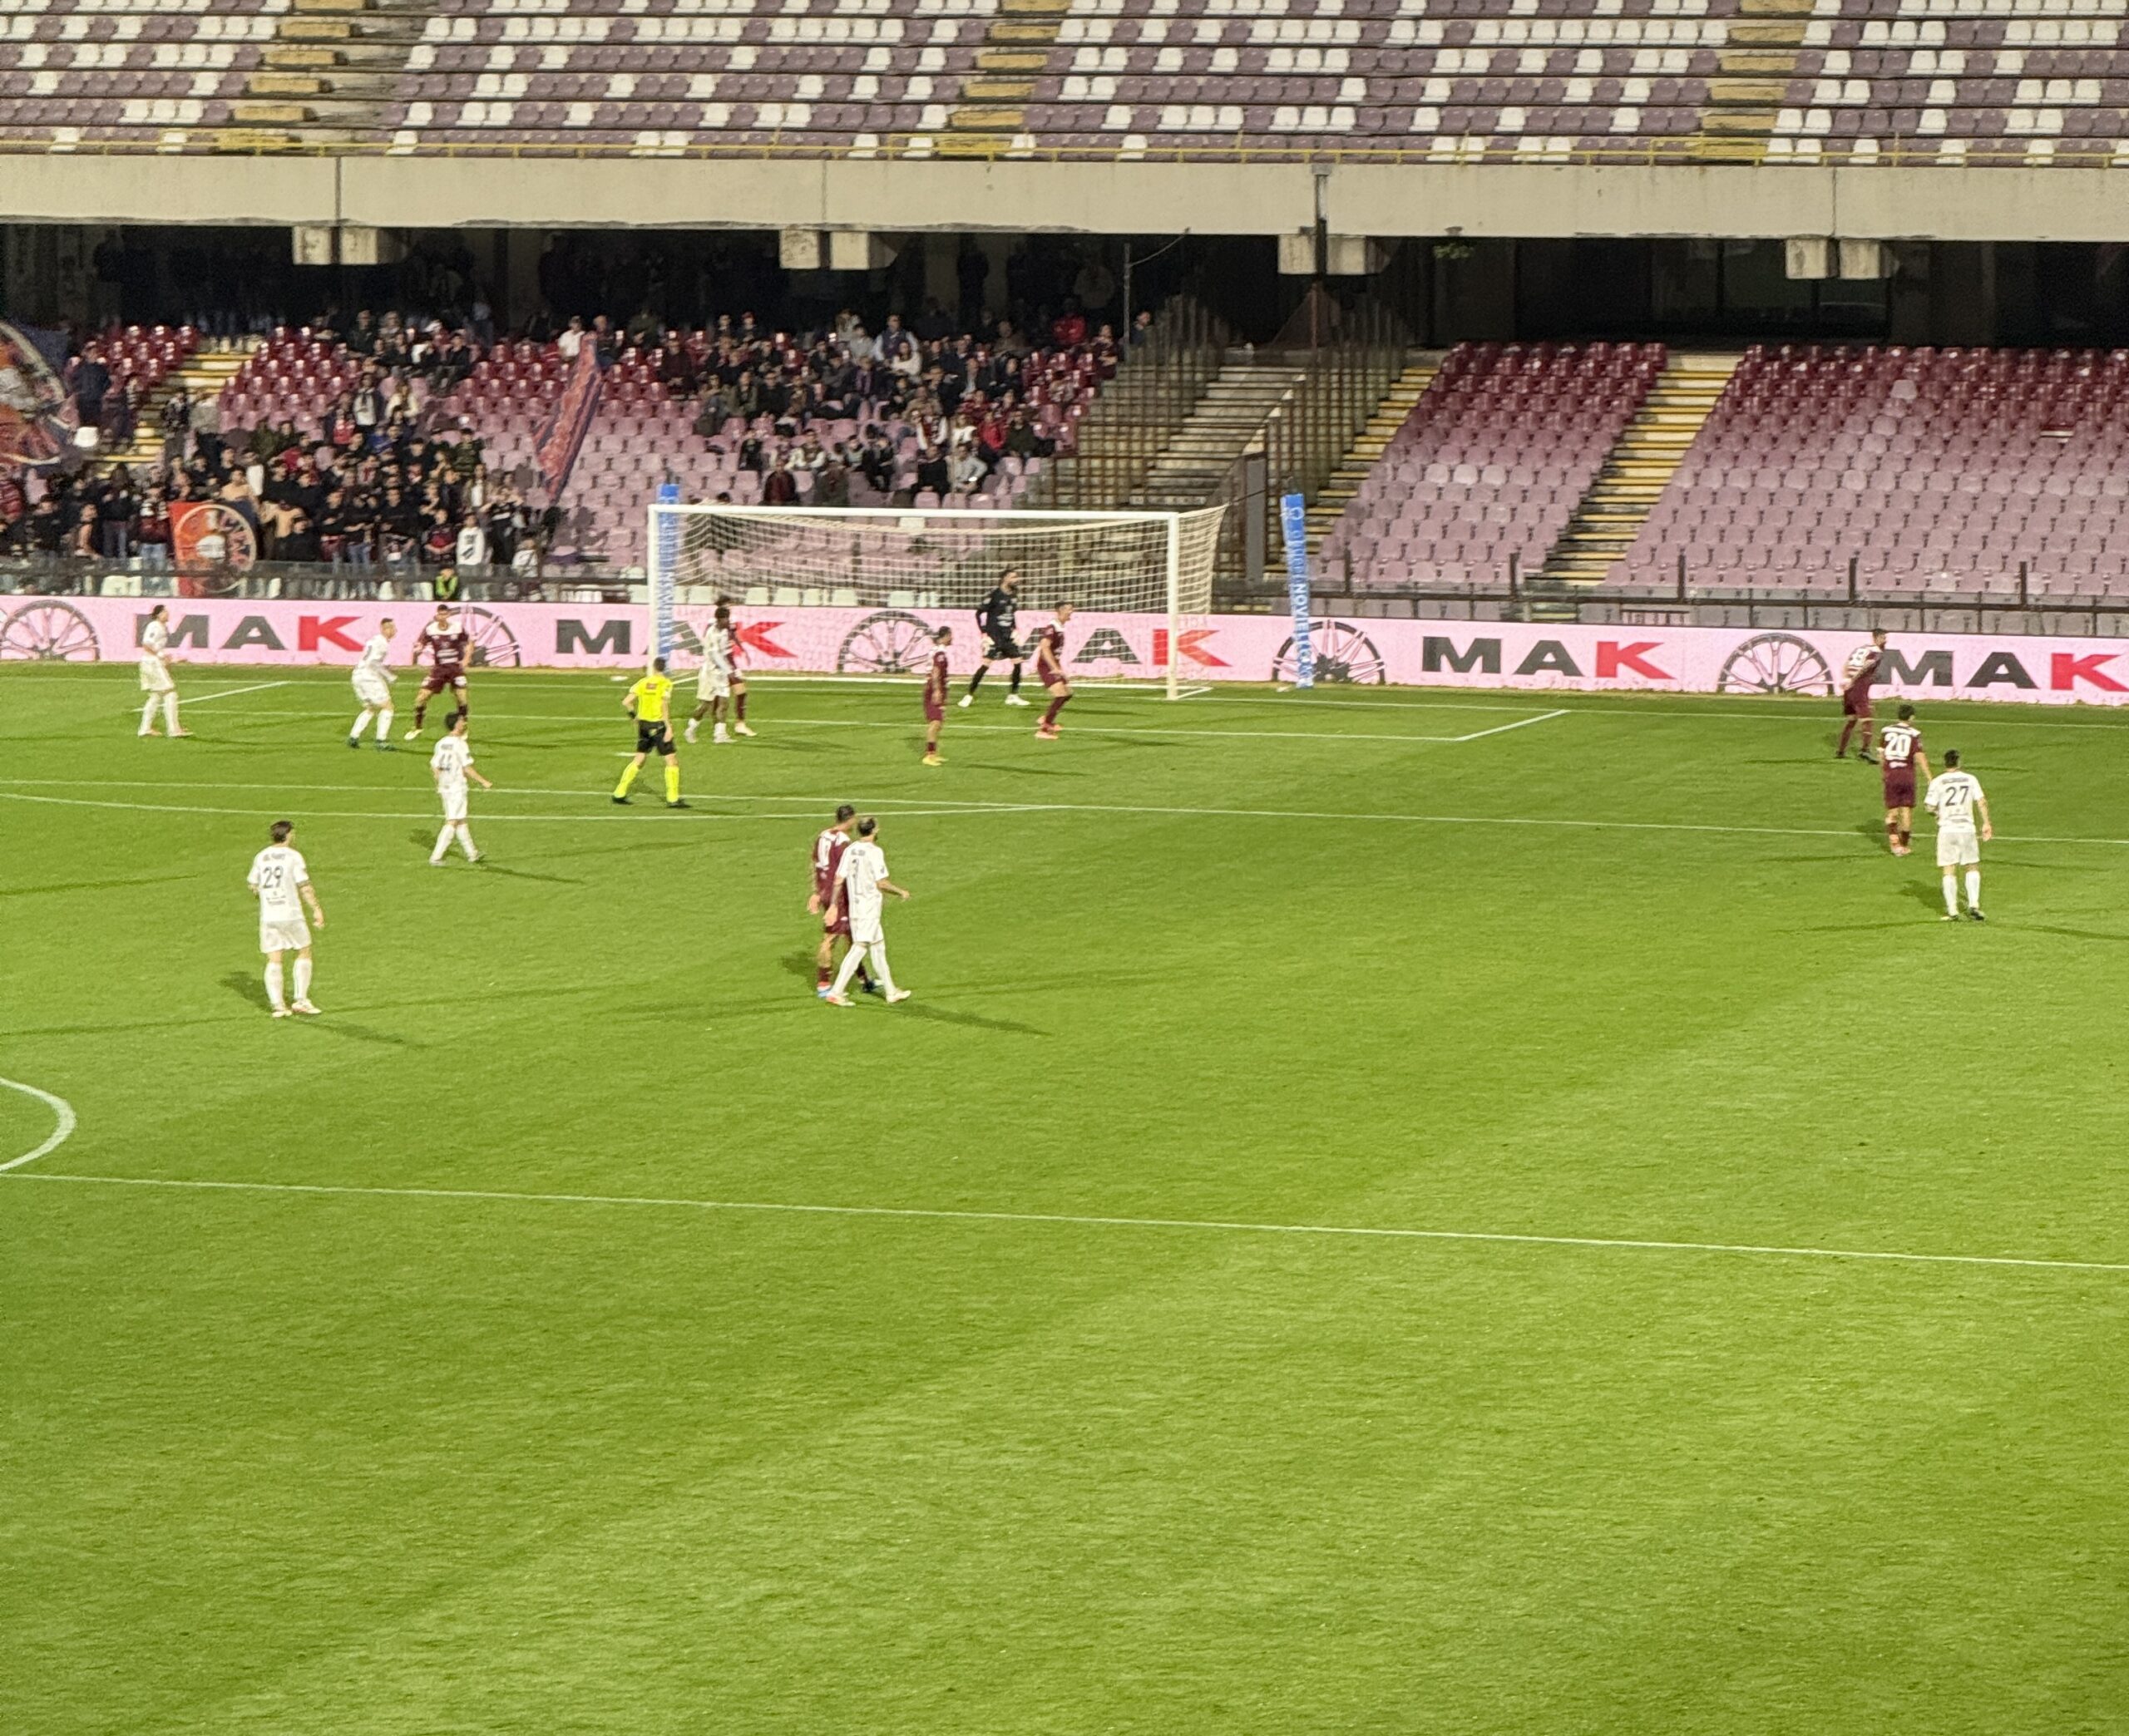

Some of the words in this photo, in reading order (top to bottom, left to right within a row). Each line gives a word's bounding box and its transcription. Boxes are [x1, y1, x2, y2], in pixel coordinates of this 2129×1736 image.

[135, 614, 365, 651] MAK
[1422, 636, 1677, 679] MAK
[1871, 649, 2129, 692] MAK
[1884, 732, 1912, 757] 20
[1945, 785, 1969, 806] 27
[263, 865, 284, 889] 29
